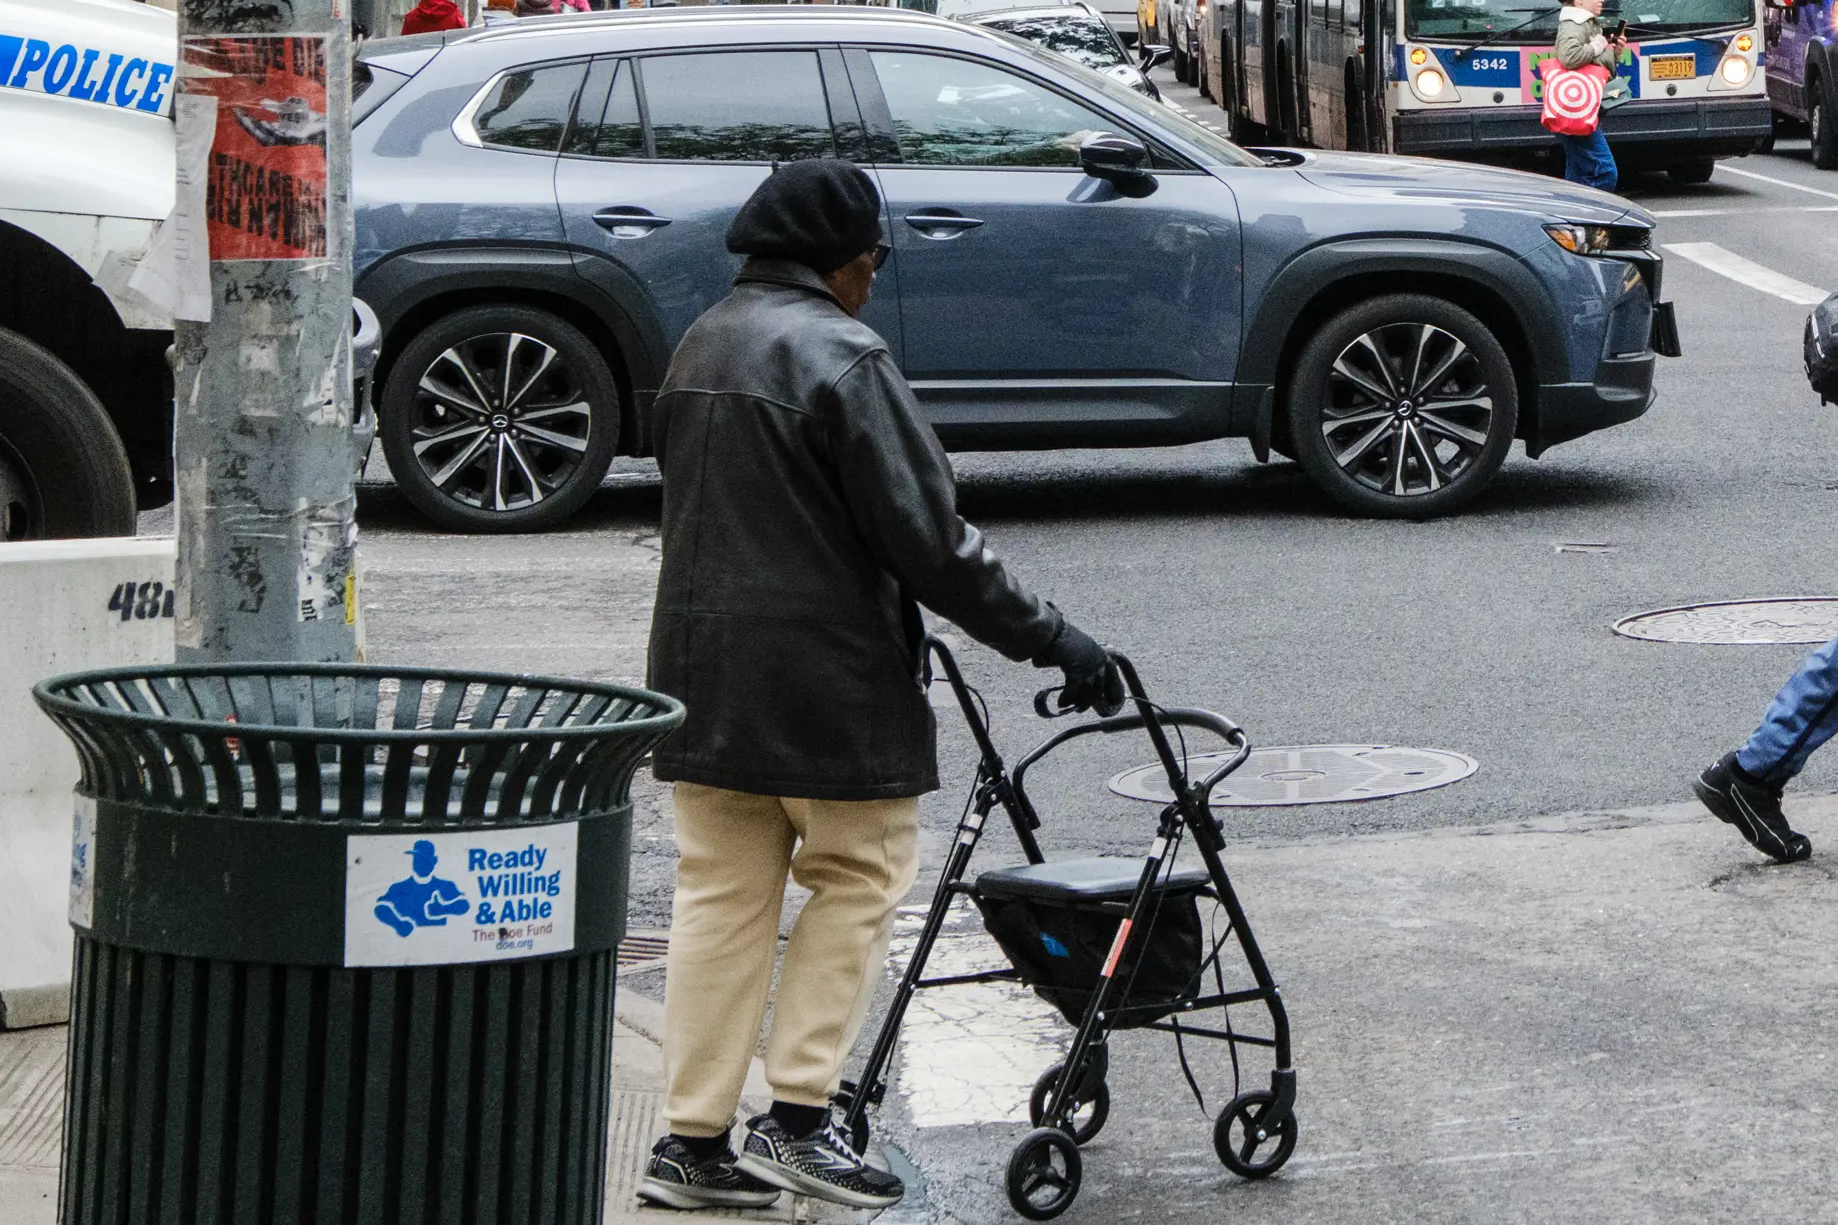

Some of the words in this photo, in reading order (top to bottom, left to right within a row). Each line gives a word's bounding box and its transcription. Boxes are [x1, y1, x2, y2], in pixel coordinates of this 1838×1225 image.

[10, 38, 174, 112] POLICE
[1472, 59, 1507, 71] 5342
[468, 843, 548, 872] Ready
[477, 869, 561, 897] Willing
[475, 901, 496, 925] &
[499, 897, 552, 923] Able
[472, 929, 495, 942] The
[527, 922, 553, 936] Fund
